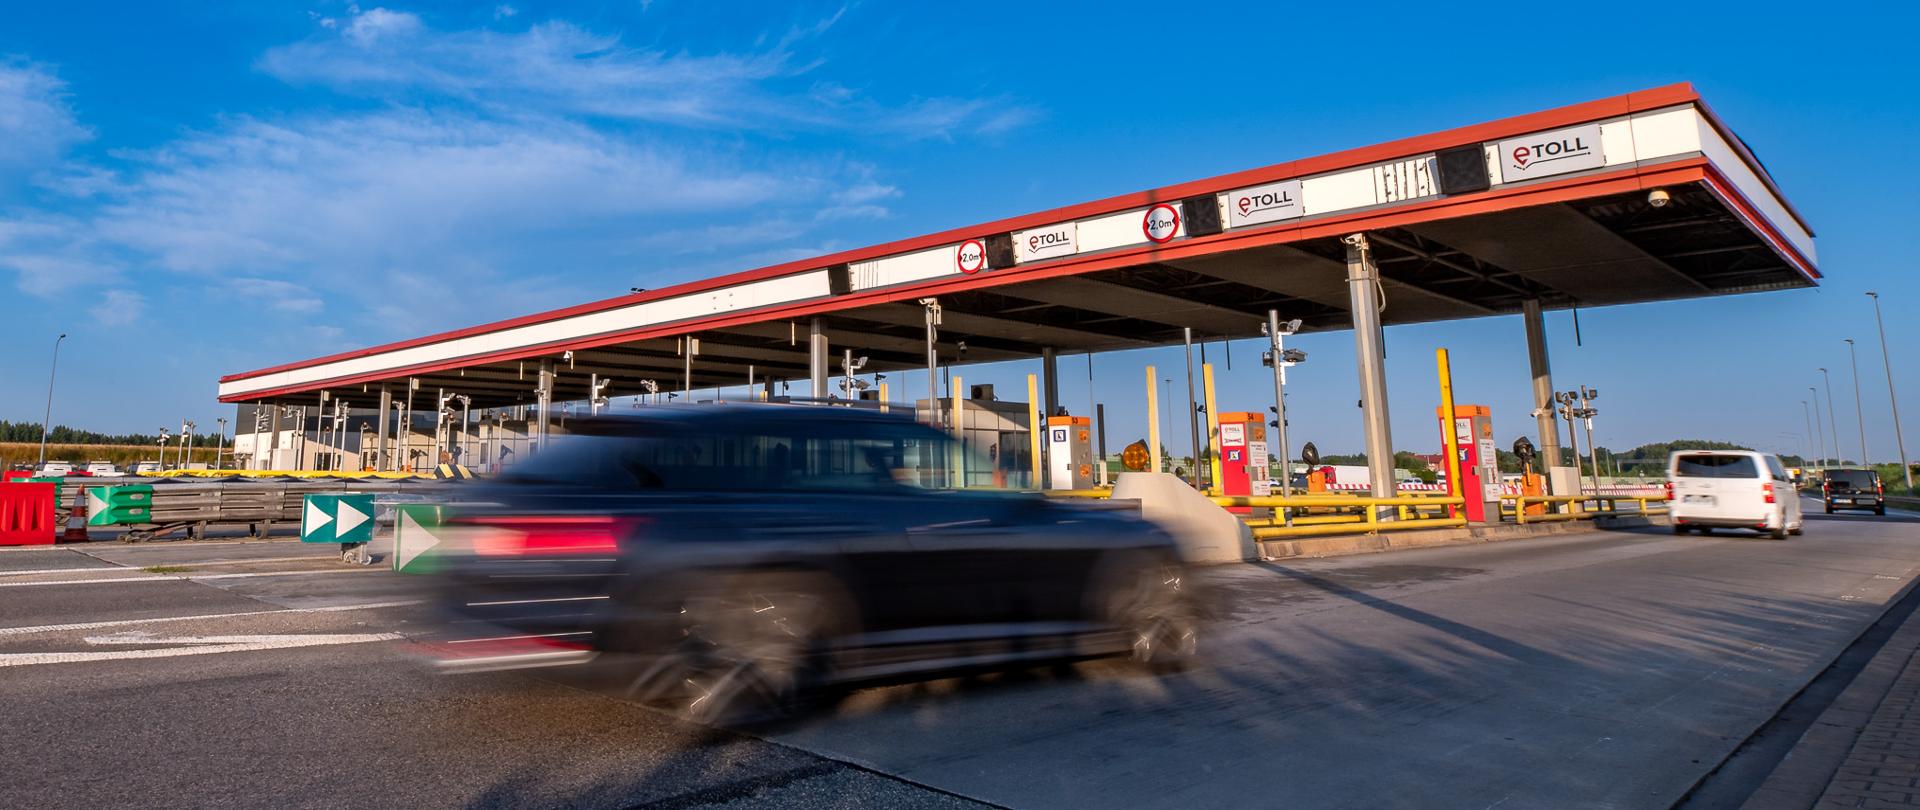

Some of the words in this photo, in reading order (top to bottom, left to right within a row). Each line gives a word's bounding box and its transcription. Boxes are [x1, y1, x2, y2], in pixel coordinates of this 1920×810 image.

[1513, 137, 1589, 166] eTOLL
[1238, 191, 1293, 214] eTOLL
[1029, 231, 1070, 250] eTOLL
